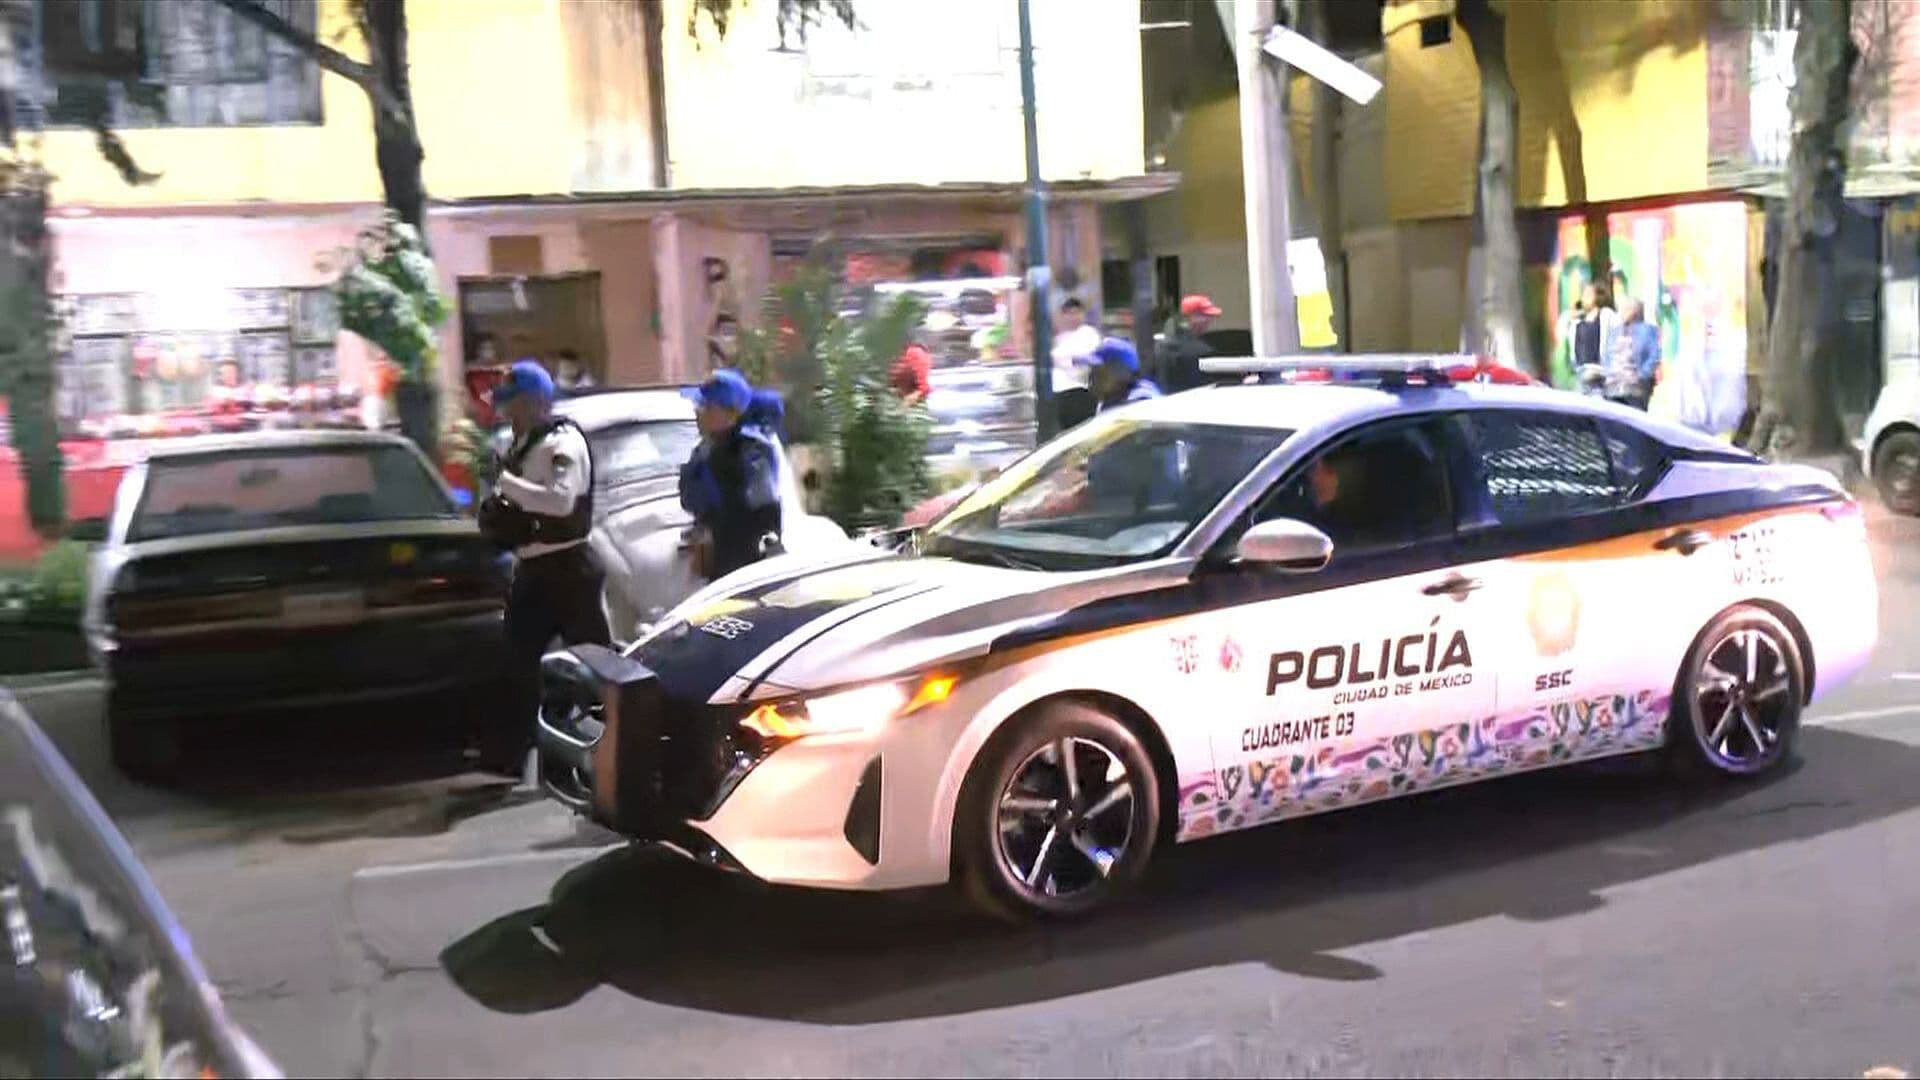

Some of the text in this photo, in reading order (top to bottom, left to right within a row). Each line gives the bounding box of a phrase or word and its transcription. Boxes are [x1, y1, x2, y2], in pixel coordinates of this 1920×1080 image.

[1266, 615, 1473, 696] POLICÍA
[1333, 685, 1389, 705] CIUDAD
[1394, 681, 1413, 697] DE
[1535, 668, 1574, 691] SSC
[1242, 711, 1355, 752] CUADRANTE 03
